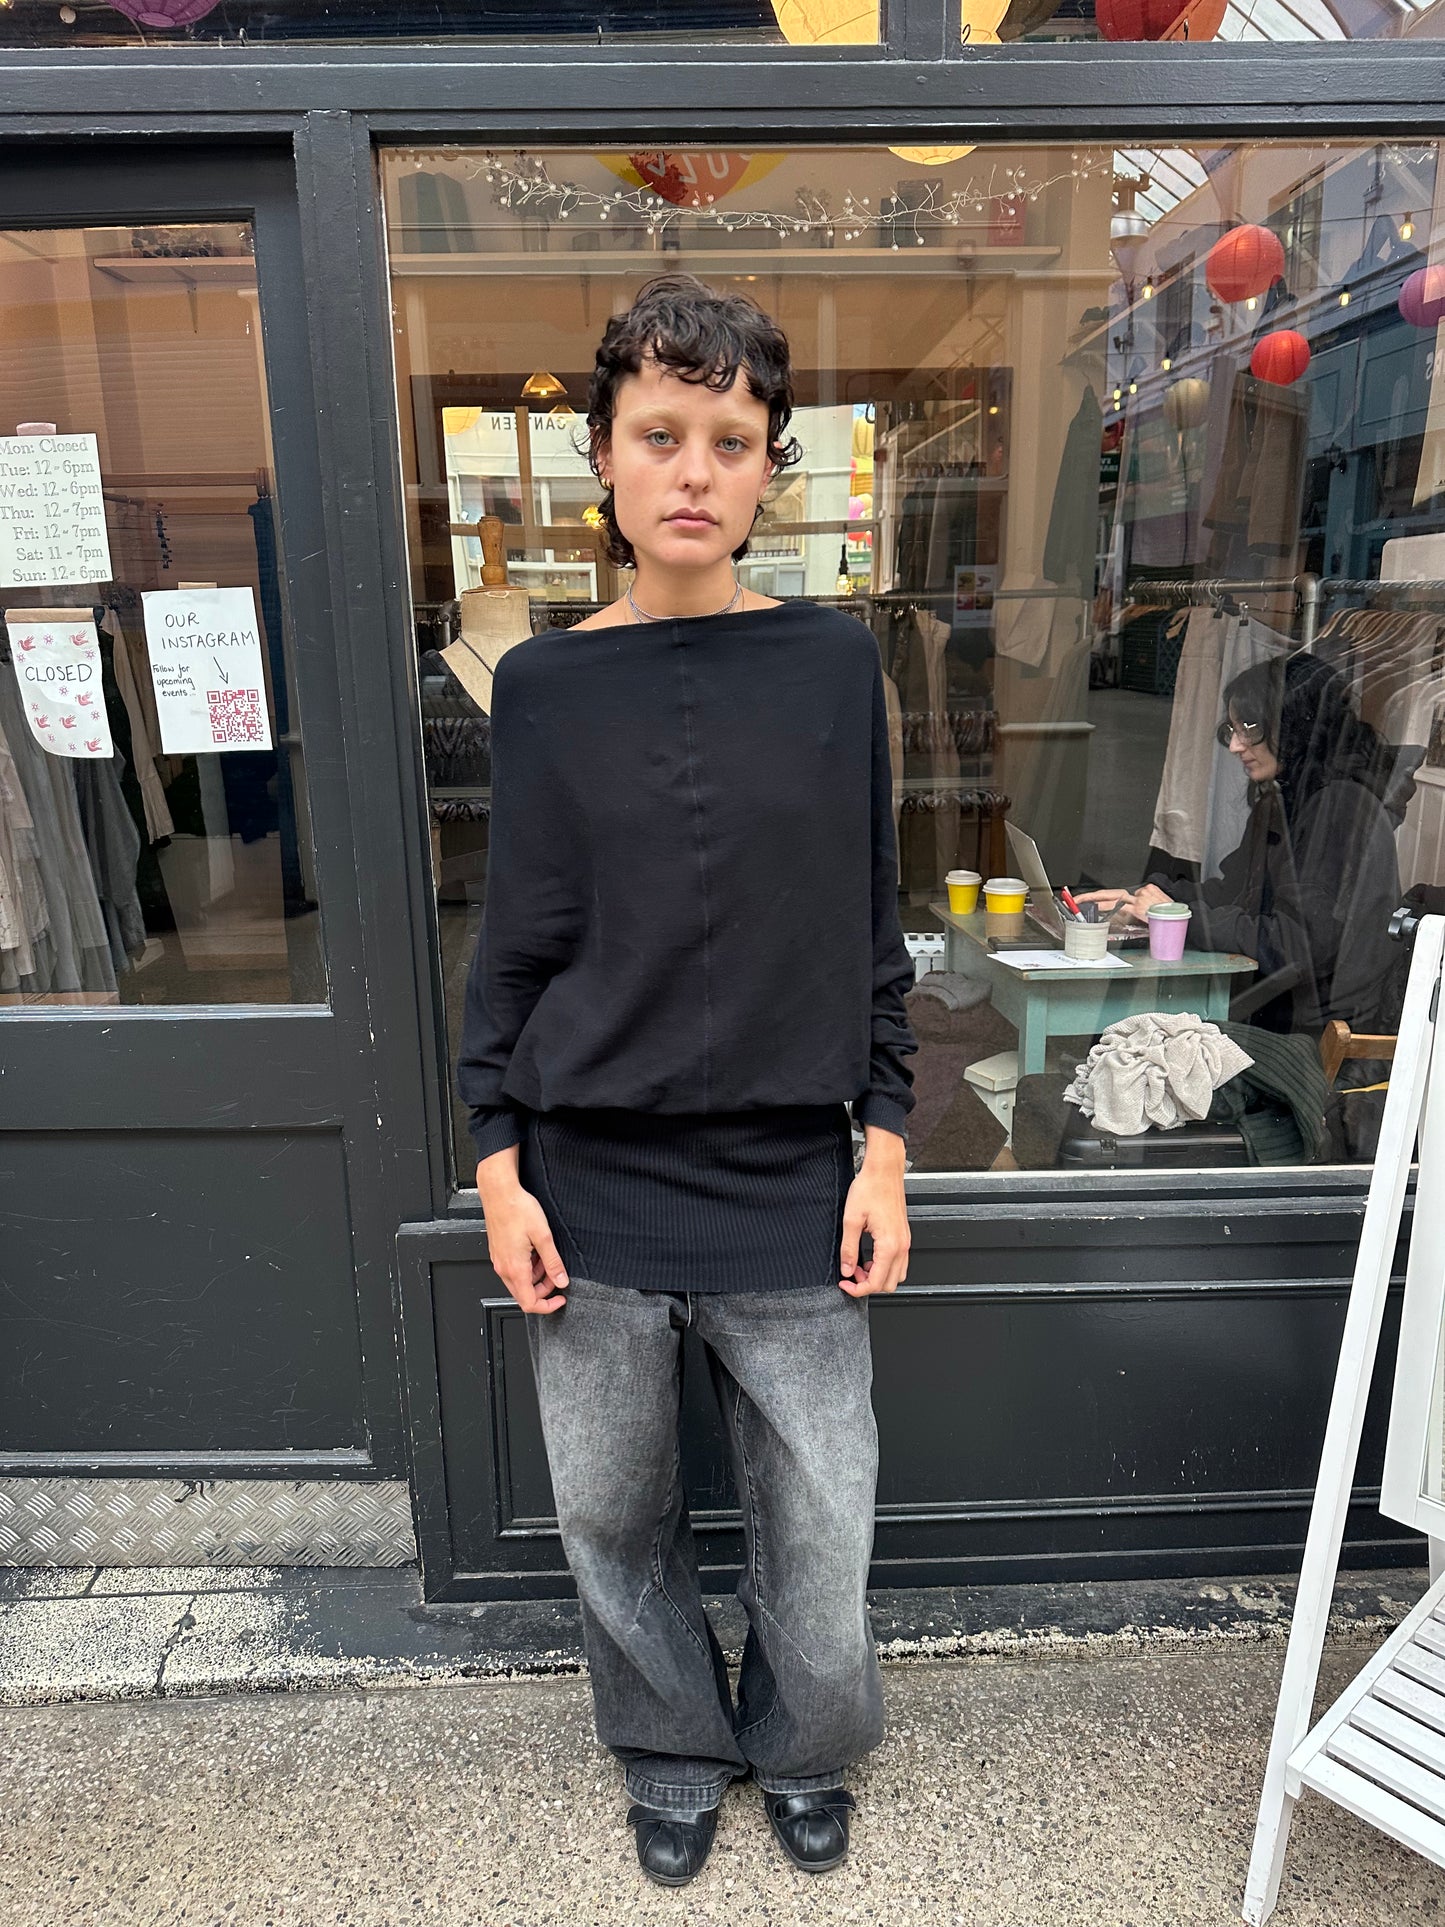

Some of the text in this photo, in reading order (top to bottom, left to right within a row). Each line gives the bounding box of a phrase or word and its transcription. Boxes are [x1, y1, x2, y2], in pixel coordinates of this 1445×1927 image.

[0, 437, 88, 455] Mon: Closed
[0, 462, 31, 476] Tue:
[0, 483, 38, 498] Wed:
[0, 505, 34, 520] Thu:
[12, 526, 39, 540] Fri:
[16, 547, 44, 561] Sat:
[12, 568, 47, 582] Sun:
[164, 611, 201, 628] OUR
[161, 630, 256, 650] INSTAGRAM
[25, 662, 93, 683] CLOSED
[152, 663, 191, 679] Follow for
[156, 677, 196, 691] upcoming
